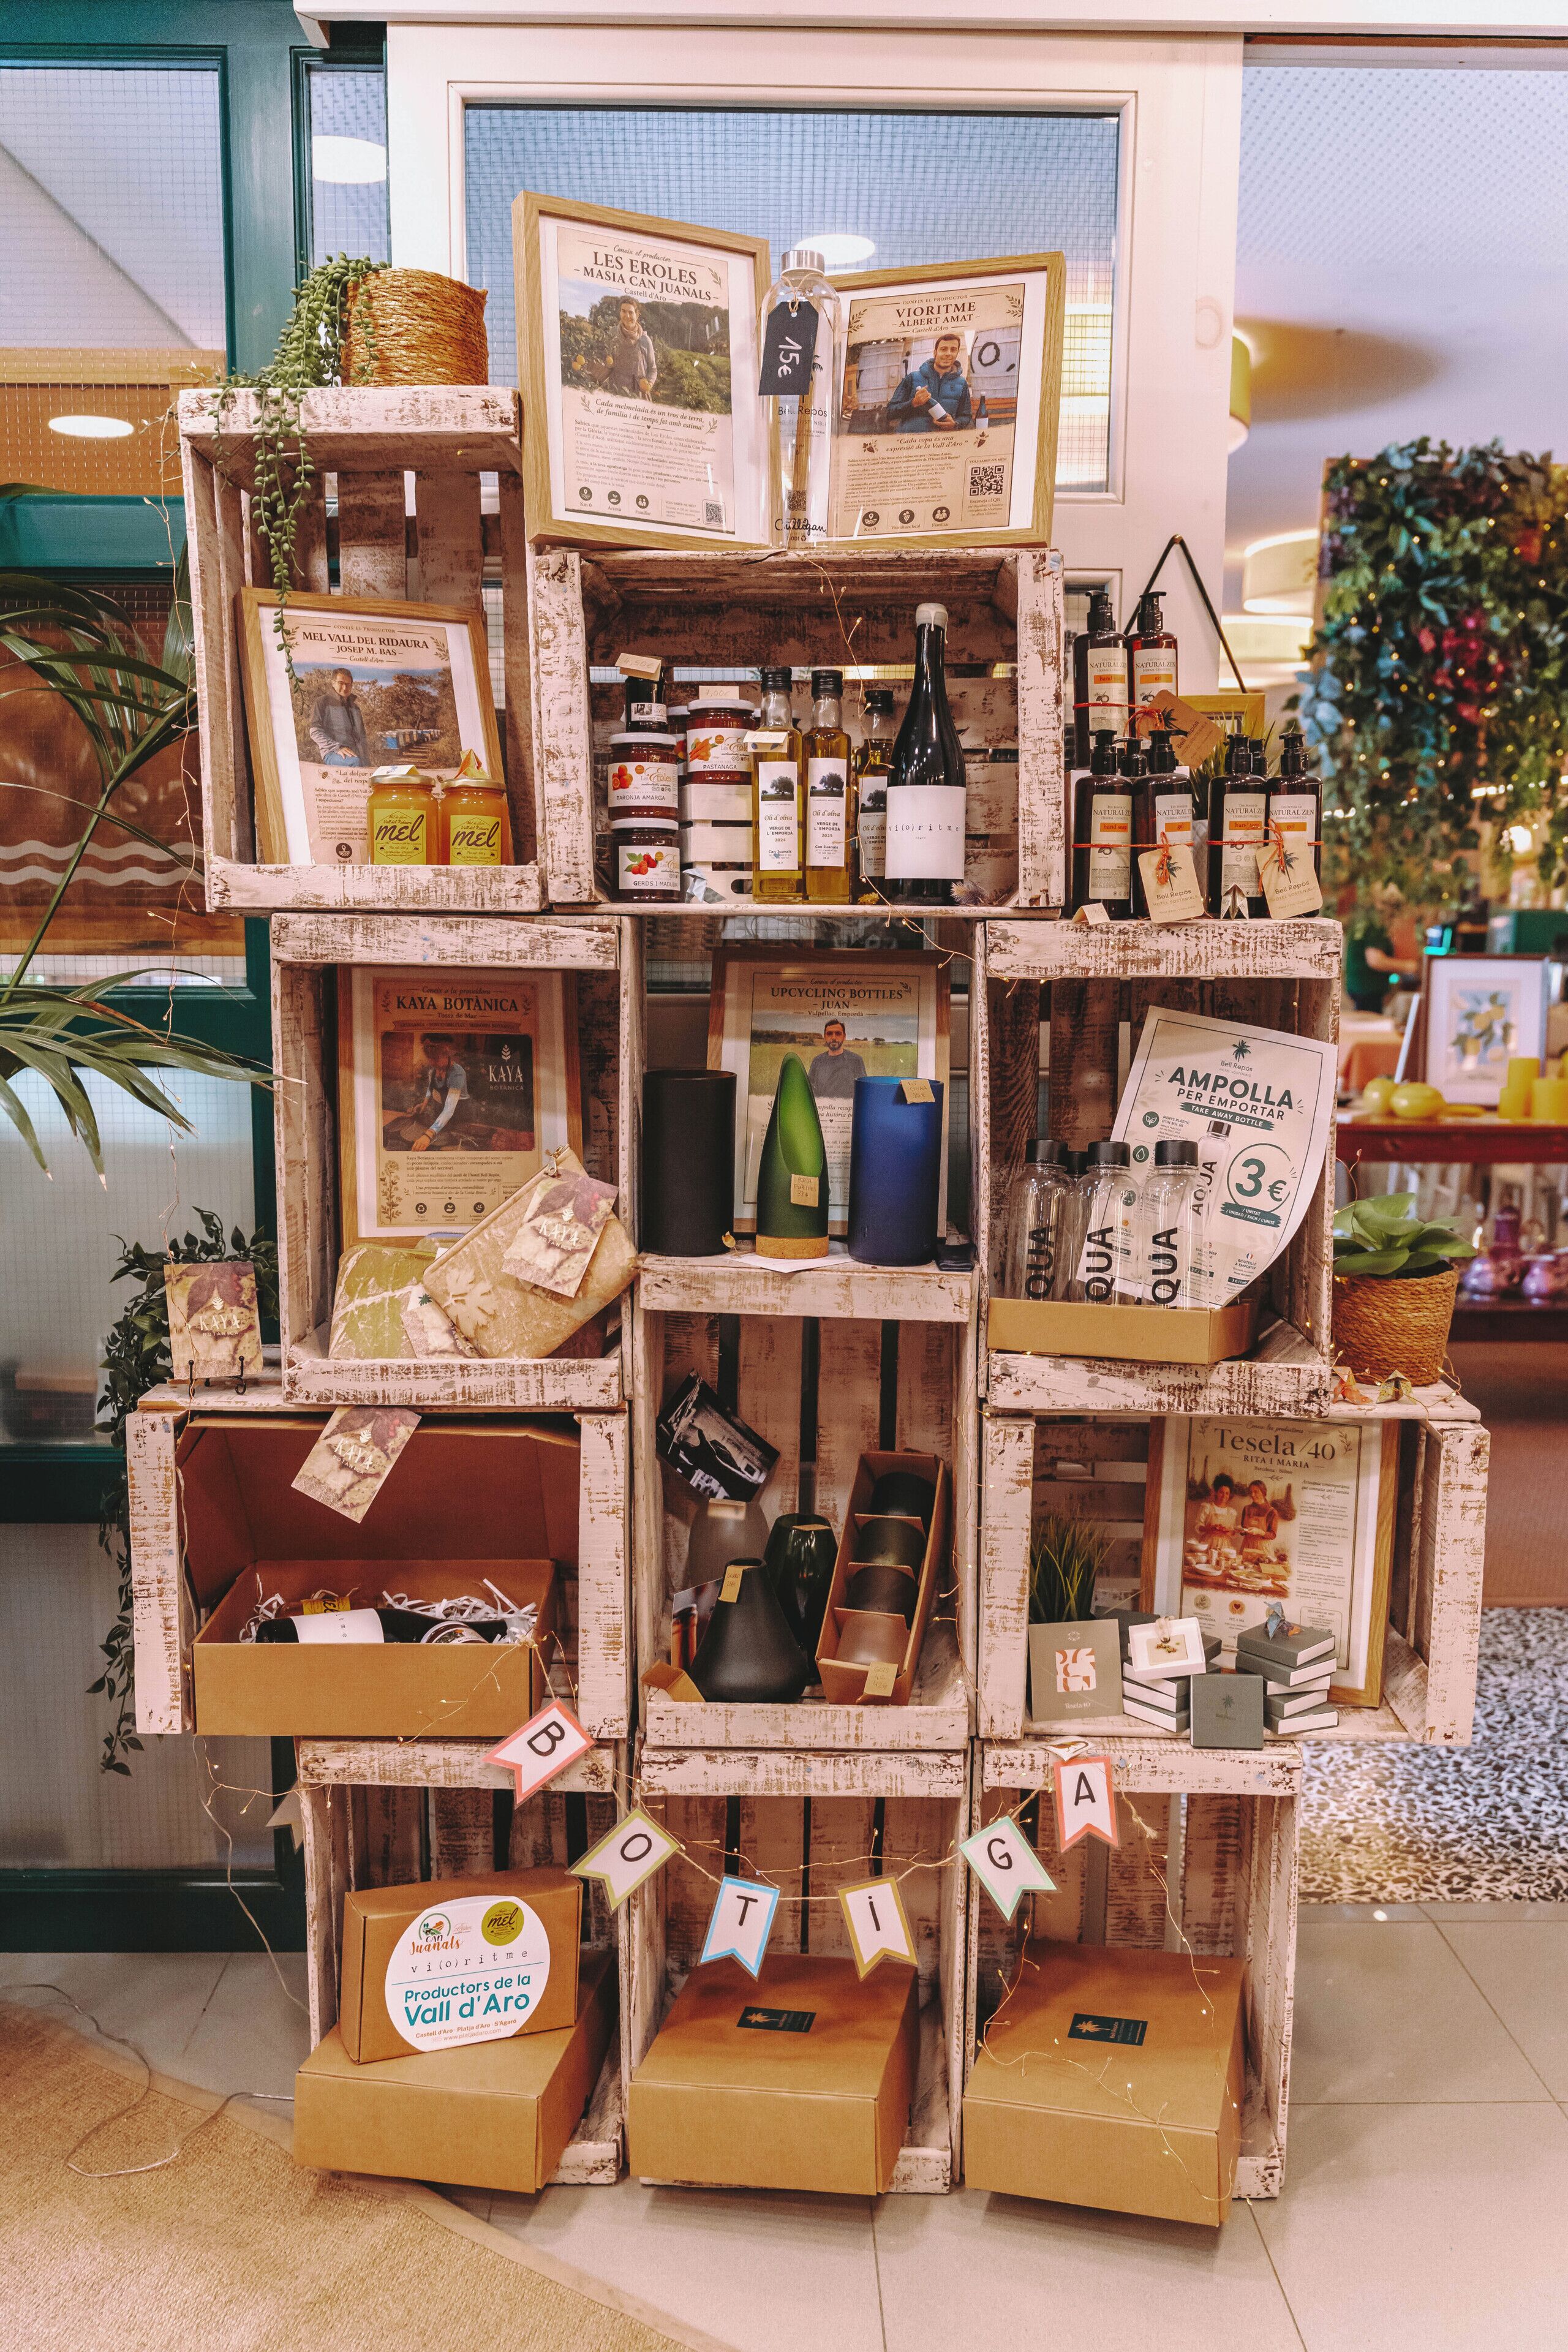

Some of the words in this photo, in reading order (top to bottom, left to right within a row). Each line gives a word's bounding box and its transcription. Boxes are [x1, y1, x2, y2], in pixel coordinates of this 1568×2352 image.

[614, 245, 633, 254] Coneix
[593, 251, 624, 270] LES
[629, 259, 697, 285] EROLES
[583, 266, 625, 284] MASIA
[629, 276, 656, 290] CAN
[660, 282, 711, 301] JUANALS
[624, 288, 647, 298] Castell
[649, 293, 666, 301] d'Aro
[895, 301, 976, 318] VIORITME
[899, 317, 940, 327] ALBERT
[943, 314, 974, 323] AMAT
[777, 336, 802, 379] 15€
[596, 399, 613, 408] Cada
[615, 402, 649, 413] melmelada
[798, 405, 827, 417] Repòs
[641, 416, 658, 424] temps
[659, 417, 668, 426] fet
[775, 518, 826, 536] Culligan
[303, 631, 326, 641] MEL
[328, 633, 355, 644] VALL
[357, 636, 377, 645] DEL
[379, 638, 429, 649] RIDAURA
[336, 645, 364, 654] JOSEP
[375, 814, 424, 842] mel
[451, 821, 500, 848] mel
[1275, 886, 1287, 895] Bell
[396, 997, 437, 1010] KAYA
[443, 995, 518, 1011] BOTÀNICA
[771, 987, 845, 998] UPCYCLING
[850, 989, 903, 1000] BOTTLES
[821, 1001, 850, 1010] JUAN
[489, 1065, 523, 1082] KAYA
[1220, 1060, 1232, 1069] Bell
[1233, 1063, 1253, 1072] Repòs
[1167, 1066, 1294, 1110] AMPOLLA
[1177, 1088, 1203, 1102] PER
[1208, 1095, 1285, 1121] EMPORTAR
[1191, 1105, 1209, 1115] TAKE
[1211, 1110, 1234, 1121] AWAY
[1235, 1115, 1264, 1127] BOTTLE
[1235, 1158, 1266, 1197] 3
[1267, 1180, 1287, 1202] €
[539, 1219, 579, 1247] KAYA
[1025, 1225, 1055, 1300] QUA
[1085, 1226, 1116, 1302] QUA
[1152, 1227, 1182, 1305] QUA
[198, 1314, 240, 1330] KAYA
[1214, 1428, 1296, 1456] Tesela
[334, 1438, 373, 1470] KAYA
[1243, 1455, 1266, 1464] RITA
[1276, 1458, 1310, 1469] MARIA
[526, 1720, 566, 1758] B
[619, 1831, 654, 1864] O
[736, 1894, 760, 1928] T
[986, 1837, 1015, 1871] G
[1071, 1771, 1099, 1808] A
[488, 1907, 519, 1928] mel
[409, 1936, 464, 1955] Juanals
[411, 1950, 528, 1973] vi(o)ritme
[404, 1981, 490, 2003] Productors
[494, 1977, 513, 1989] de
[518, 1974, 530, 1986] la
[404, 2000, 450, 2026] Vall
[459, 1994, 530, 2018] d'Aro
[443, 2027, 502, 2041] www.platjadaro.com
